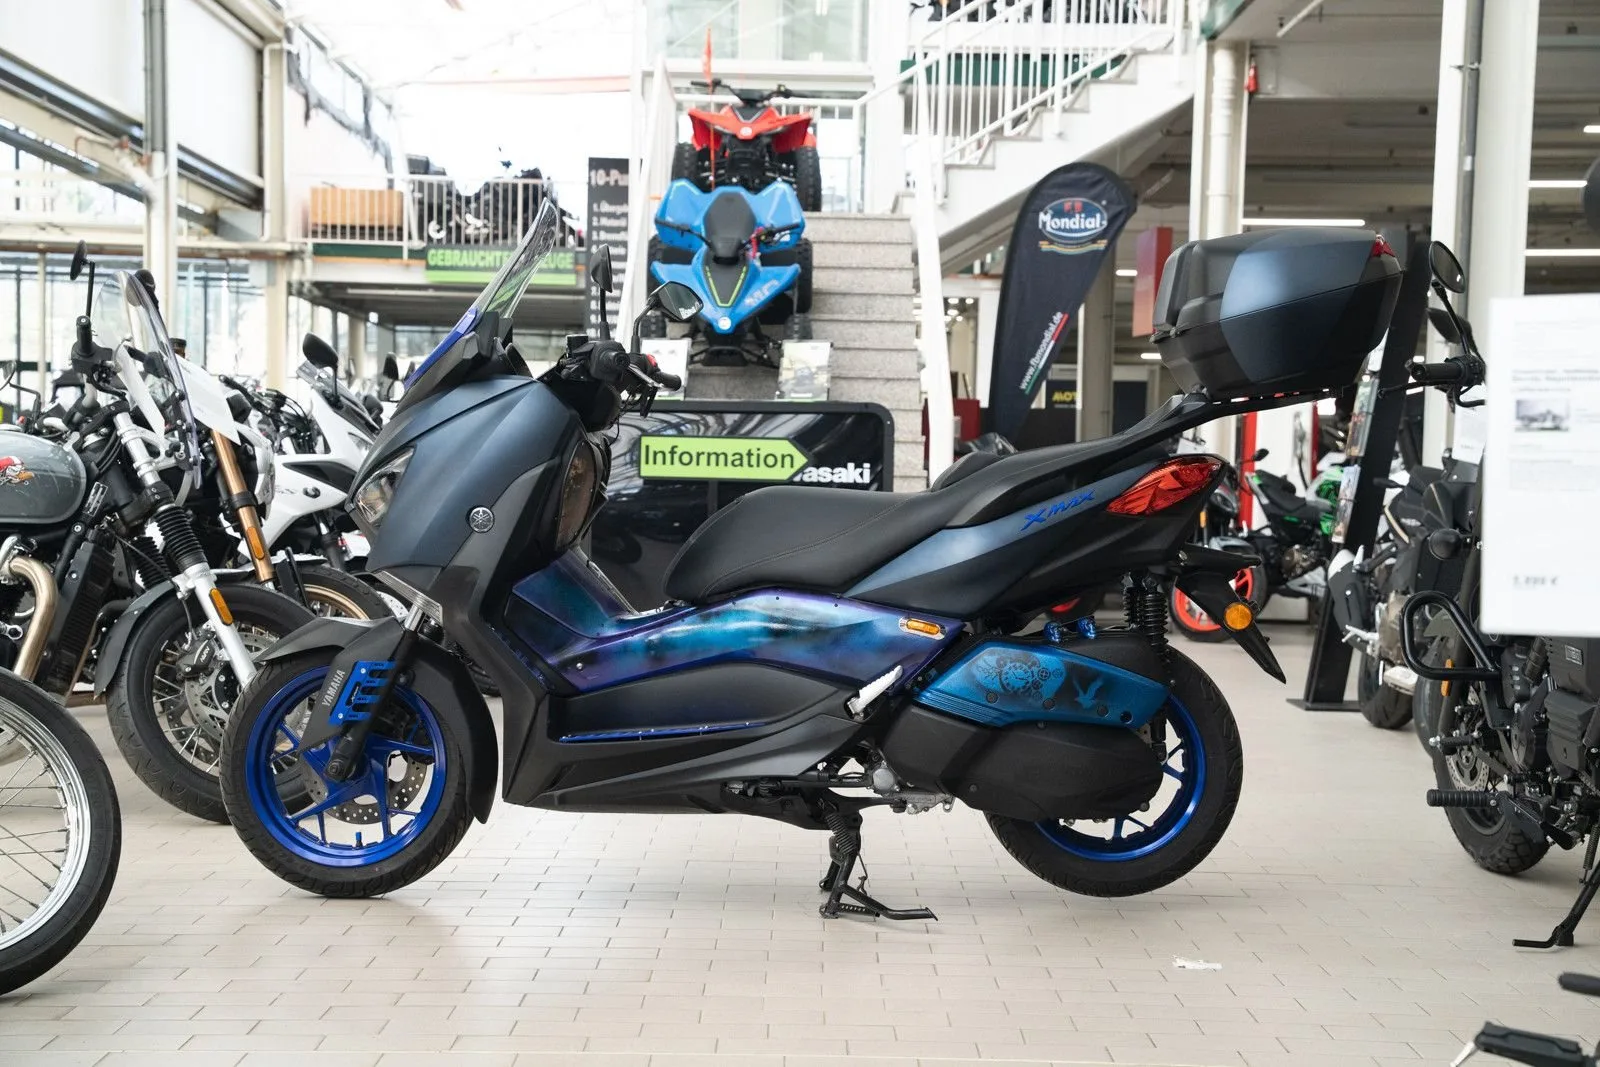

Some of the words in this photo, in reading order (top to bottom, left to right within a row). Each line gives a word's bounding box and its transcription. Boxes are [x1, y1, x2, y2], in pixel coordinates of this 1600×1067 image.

[1039, 211, 1101, 231] Mondial
[644, 444, 795, 469] Information
[321, 669, 346, 707] YAMAHA
